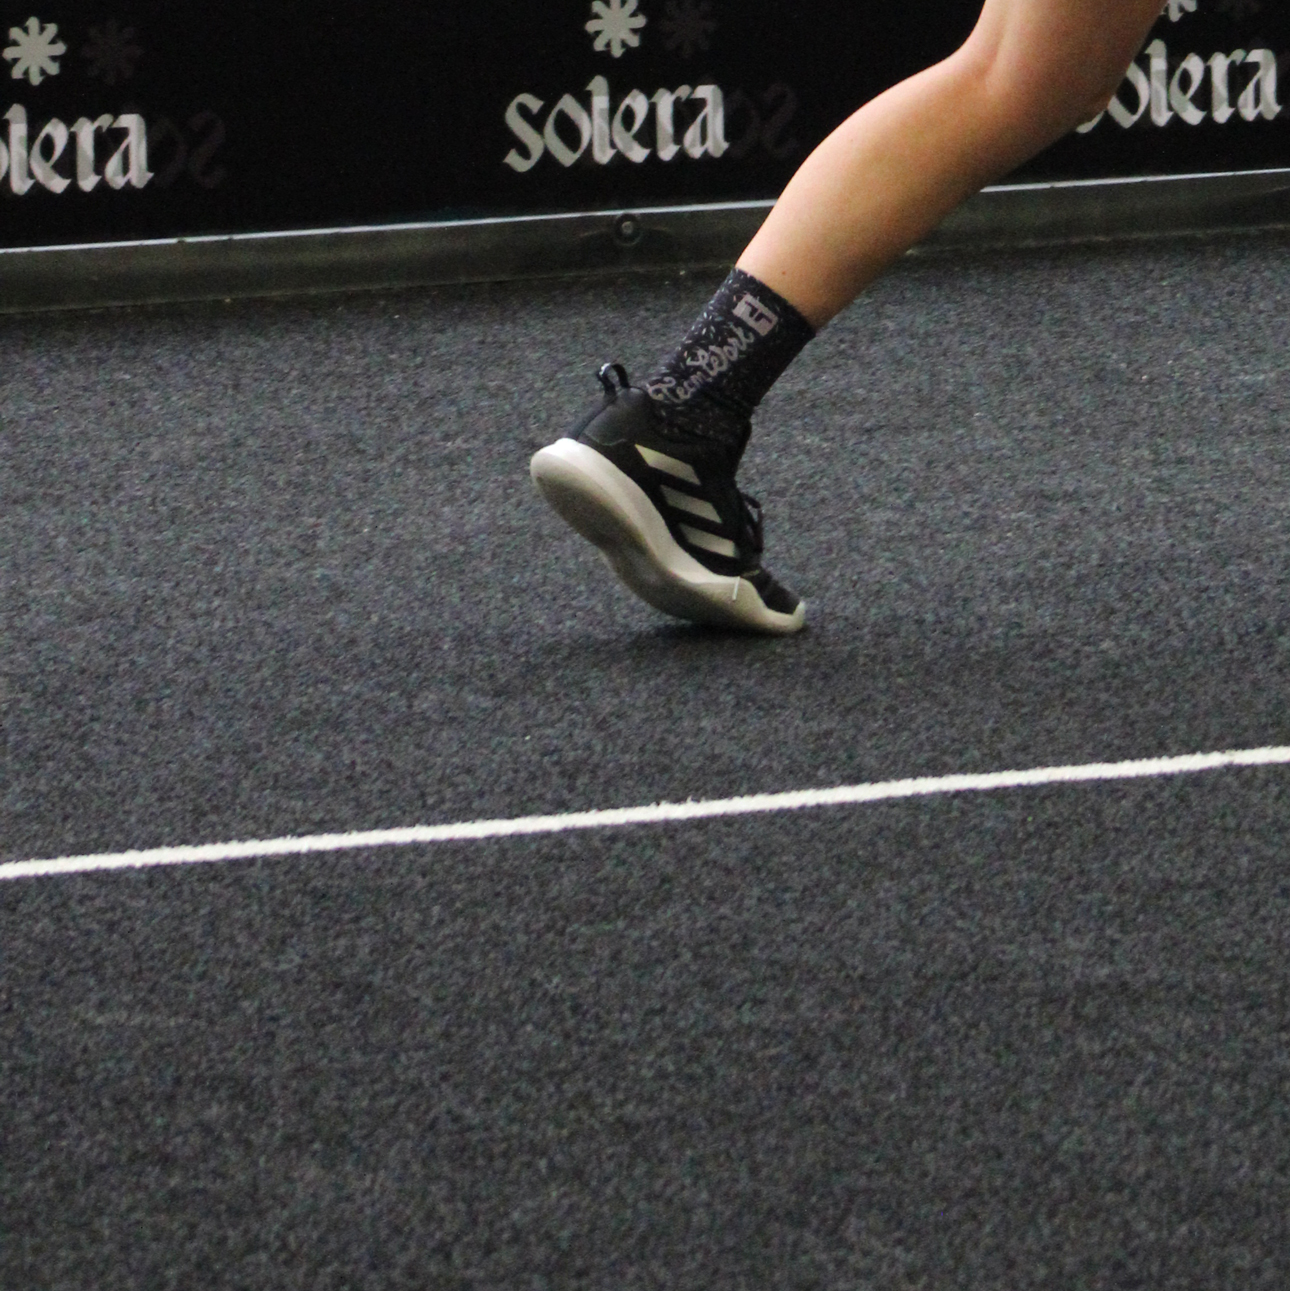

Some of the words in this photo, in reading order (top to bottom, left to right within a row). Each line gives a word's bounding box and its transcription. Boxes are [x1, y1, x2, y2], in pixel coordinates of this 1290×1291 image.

[502, 74, 730, 173] solera
[1075, 38, 1282, 134] olera
[0, 103, 155, 196] lera
